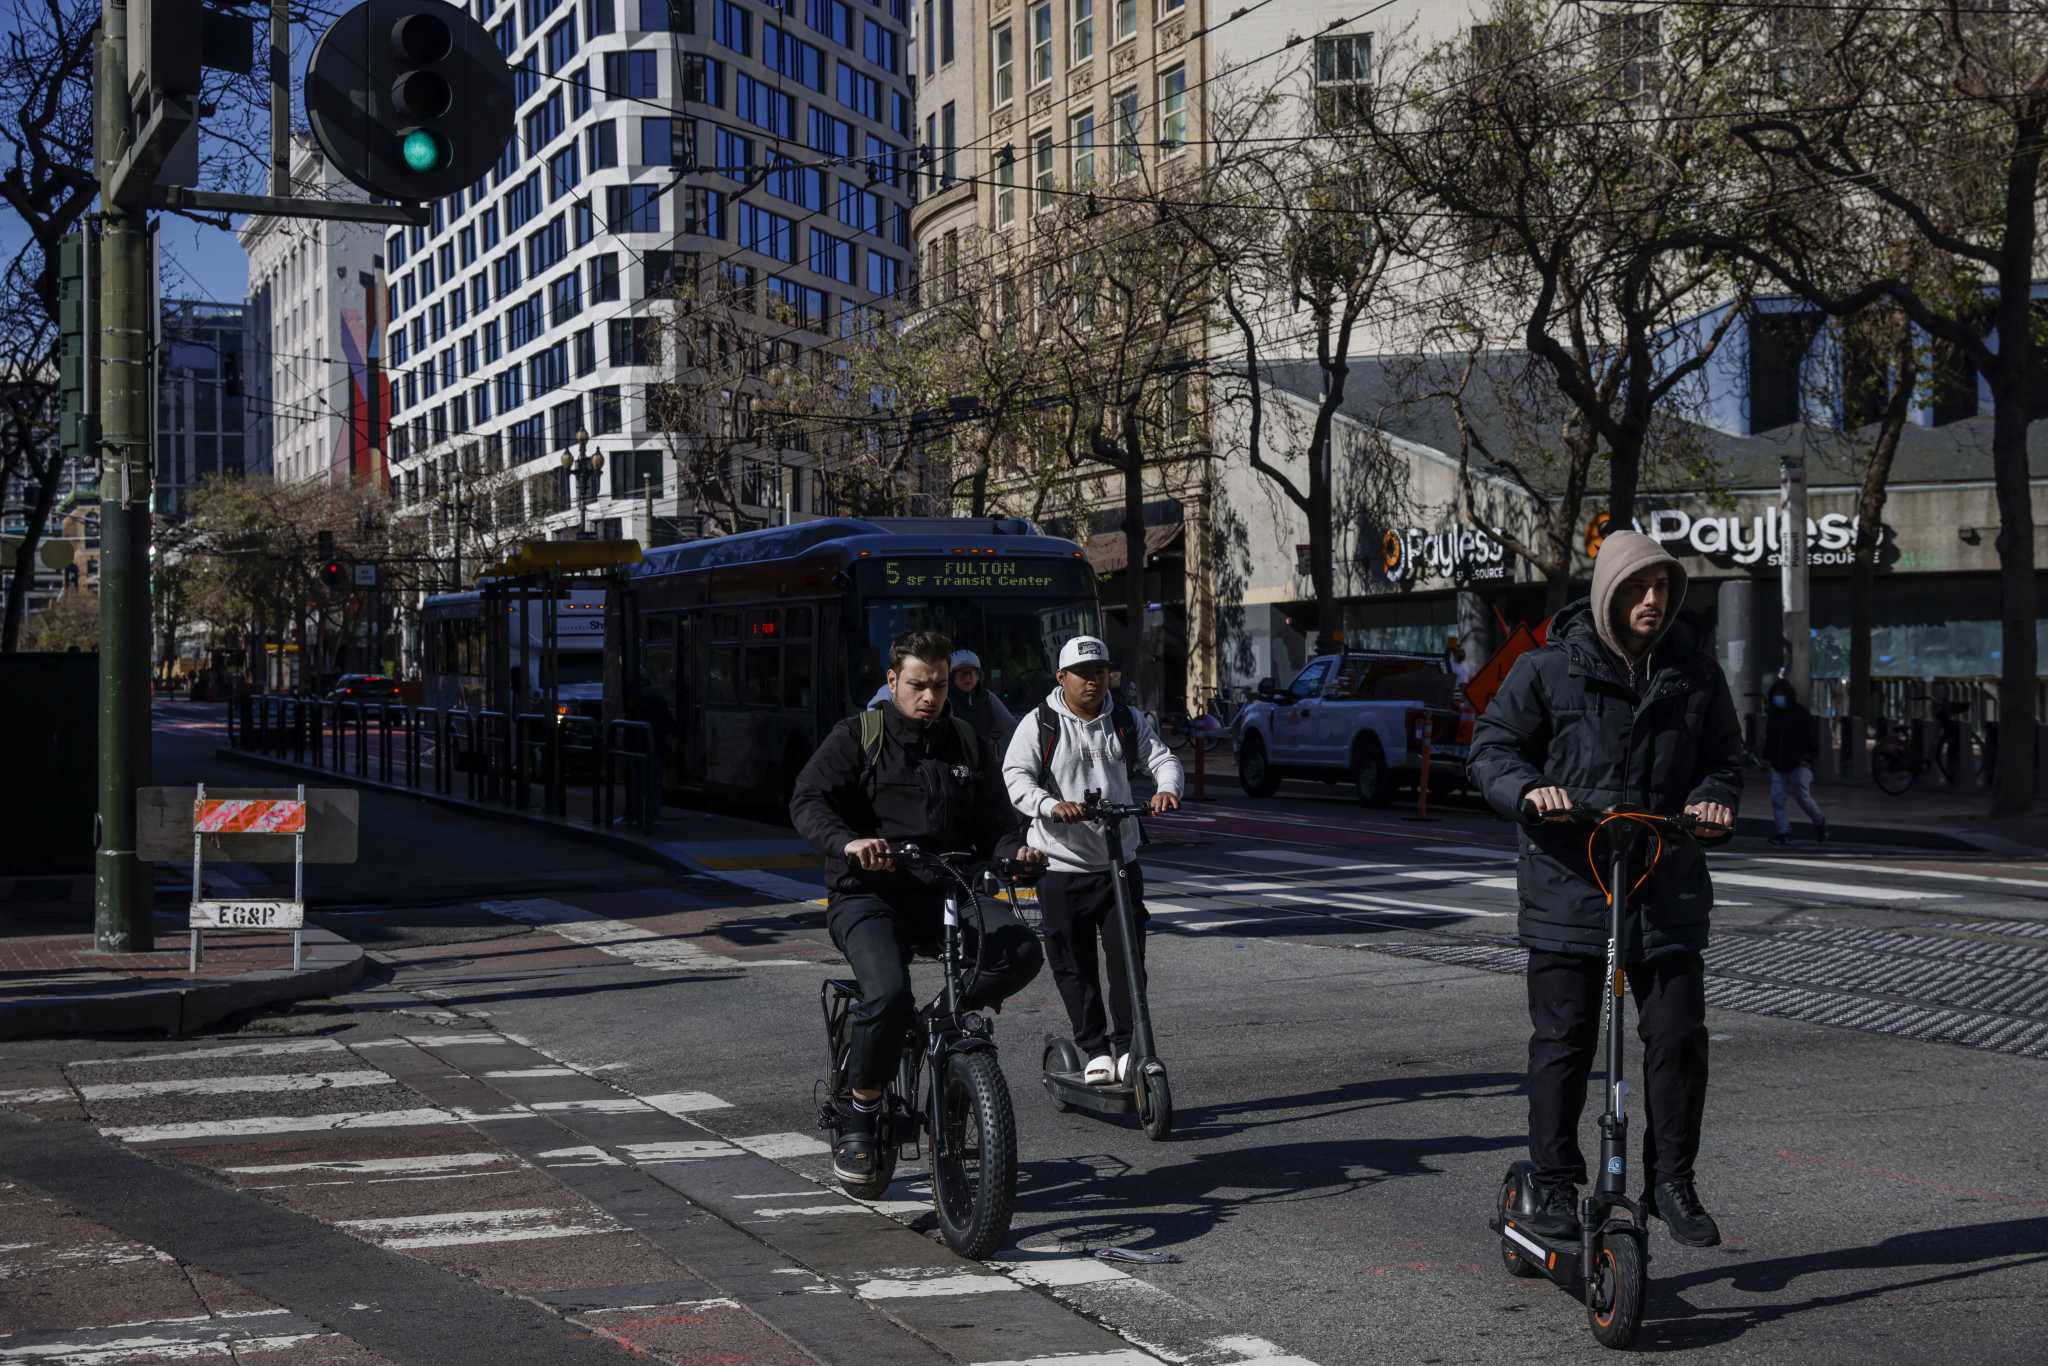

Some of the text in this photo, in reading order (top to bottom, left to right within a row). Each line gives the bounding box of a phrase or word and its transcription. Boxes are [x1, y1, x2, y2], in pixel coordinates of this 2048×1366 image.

[1406, 523, 1504, 577] Payless
[885, 561, 901, 585] 5
[944, 561, 1017, 575] FULTON
[905, 575, 1054, 586] SF Transit Center
